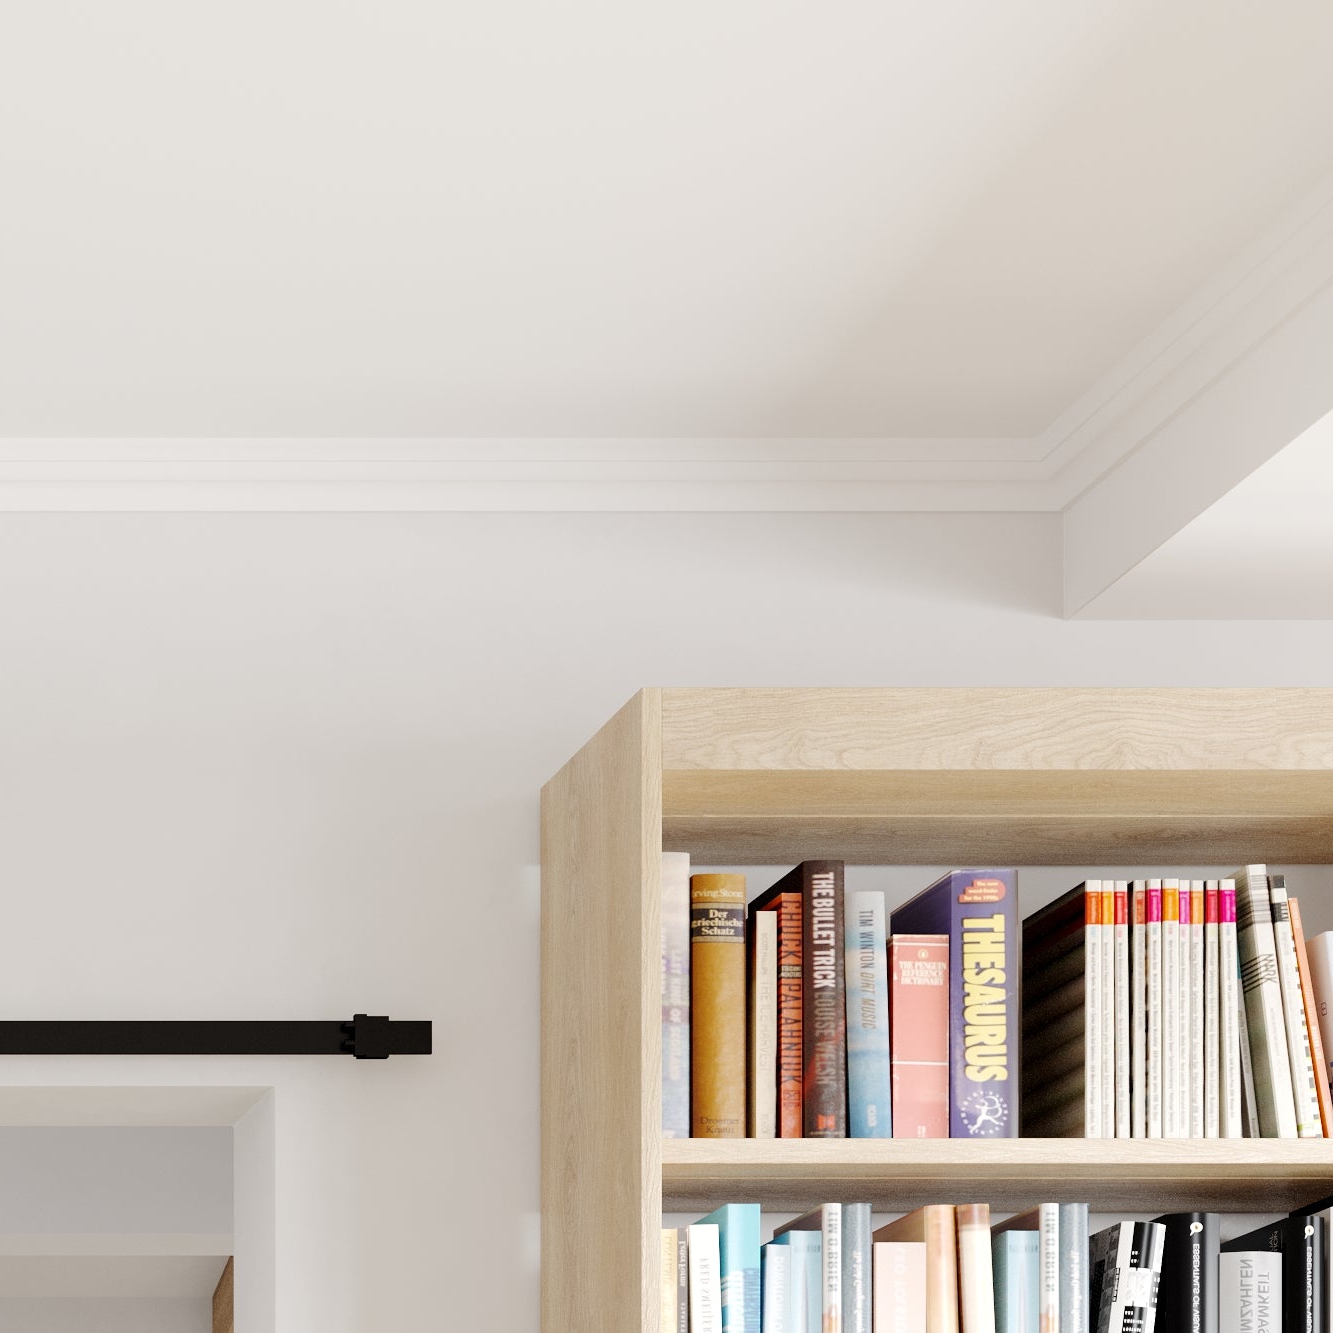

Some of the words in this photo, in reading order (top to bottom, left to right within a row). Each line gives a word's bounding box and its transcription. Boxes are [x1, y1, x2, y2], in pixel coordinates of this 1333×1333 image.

[812, 873, 835, 899] THE
[701, 927, 735, 935] Schatz
[709, 909, 728, 918] Der
[780, 899, 802, 959] CHUCK
[812, 899, 835, 945] BULLET
[858, 910, 874, 927] TIM
[859, 931, 875, 969] WINTON
[915, 960, 947, 969] PENGUIN
[813, 949, 835, 989] TRICK
[860, 972, 875, 994] DIRT
[900, 977, 943, 985] DICTIONARY
[813, 991, 835, 1036] LOUISE
[861, 997, 876, 1029] MUSIC
[962, 913, 1008, 1082] THESAURUS
[781, 983, 802, 1084] PALAHNIUK
[816, 1042, 836, 1085] WELSH
